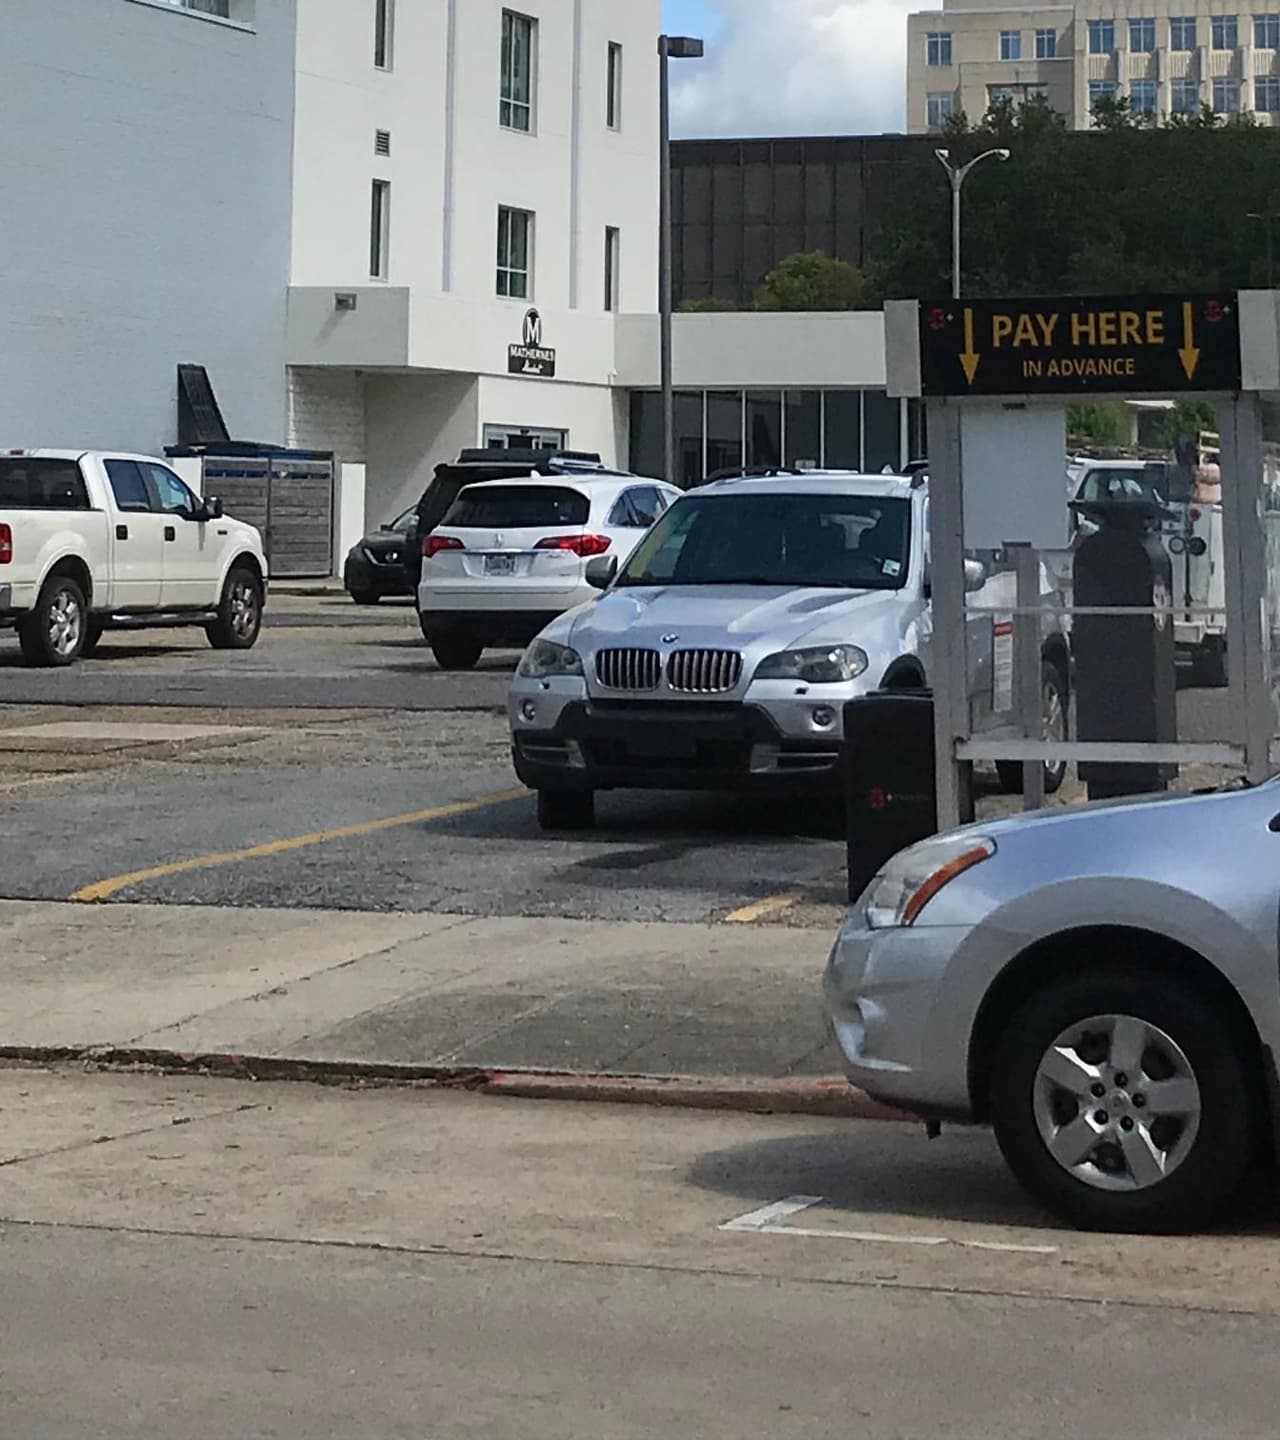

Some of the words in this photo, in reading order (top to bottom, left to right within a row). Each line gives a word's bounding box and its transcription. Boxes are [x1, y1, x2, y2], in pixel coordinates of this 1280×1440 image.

[526, 316, 540, 343] M
[992, 313, 1058, 347] PAY
[1071, 310, 1165, 345] HERE
[1023, 359, 1042, 377] IN
[1047, 357, 1135, 376] ADVANCE
